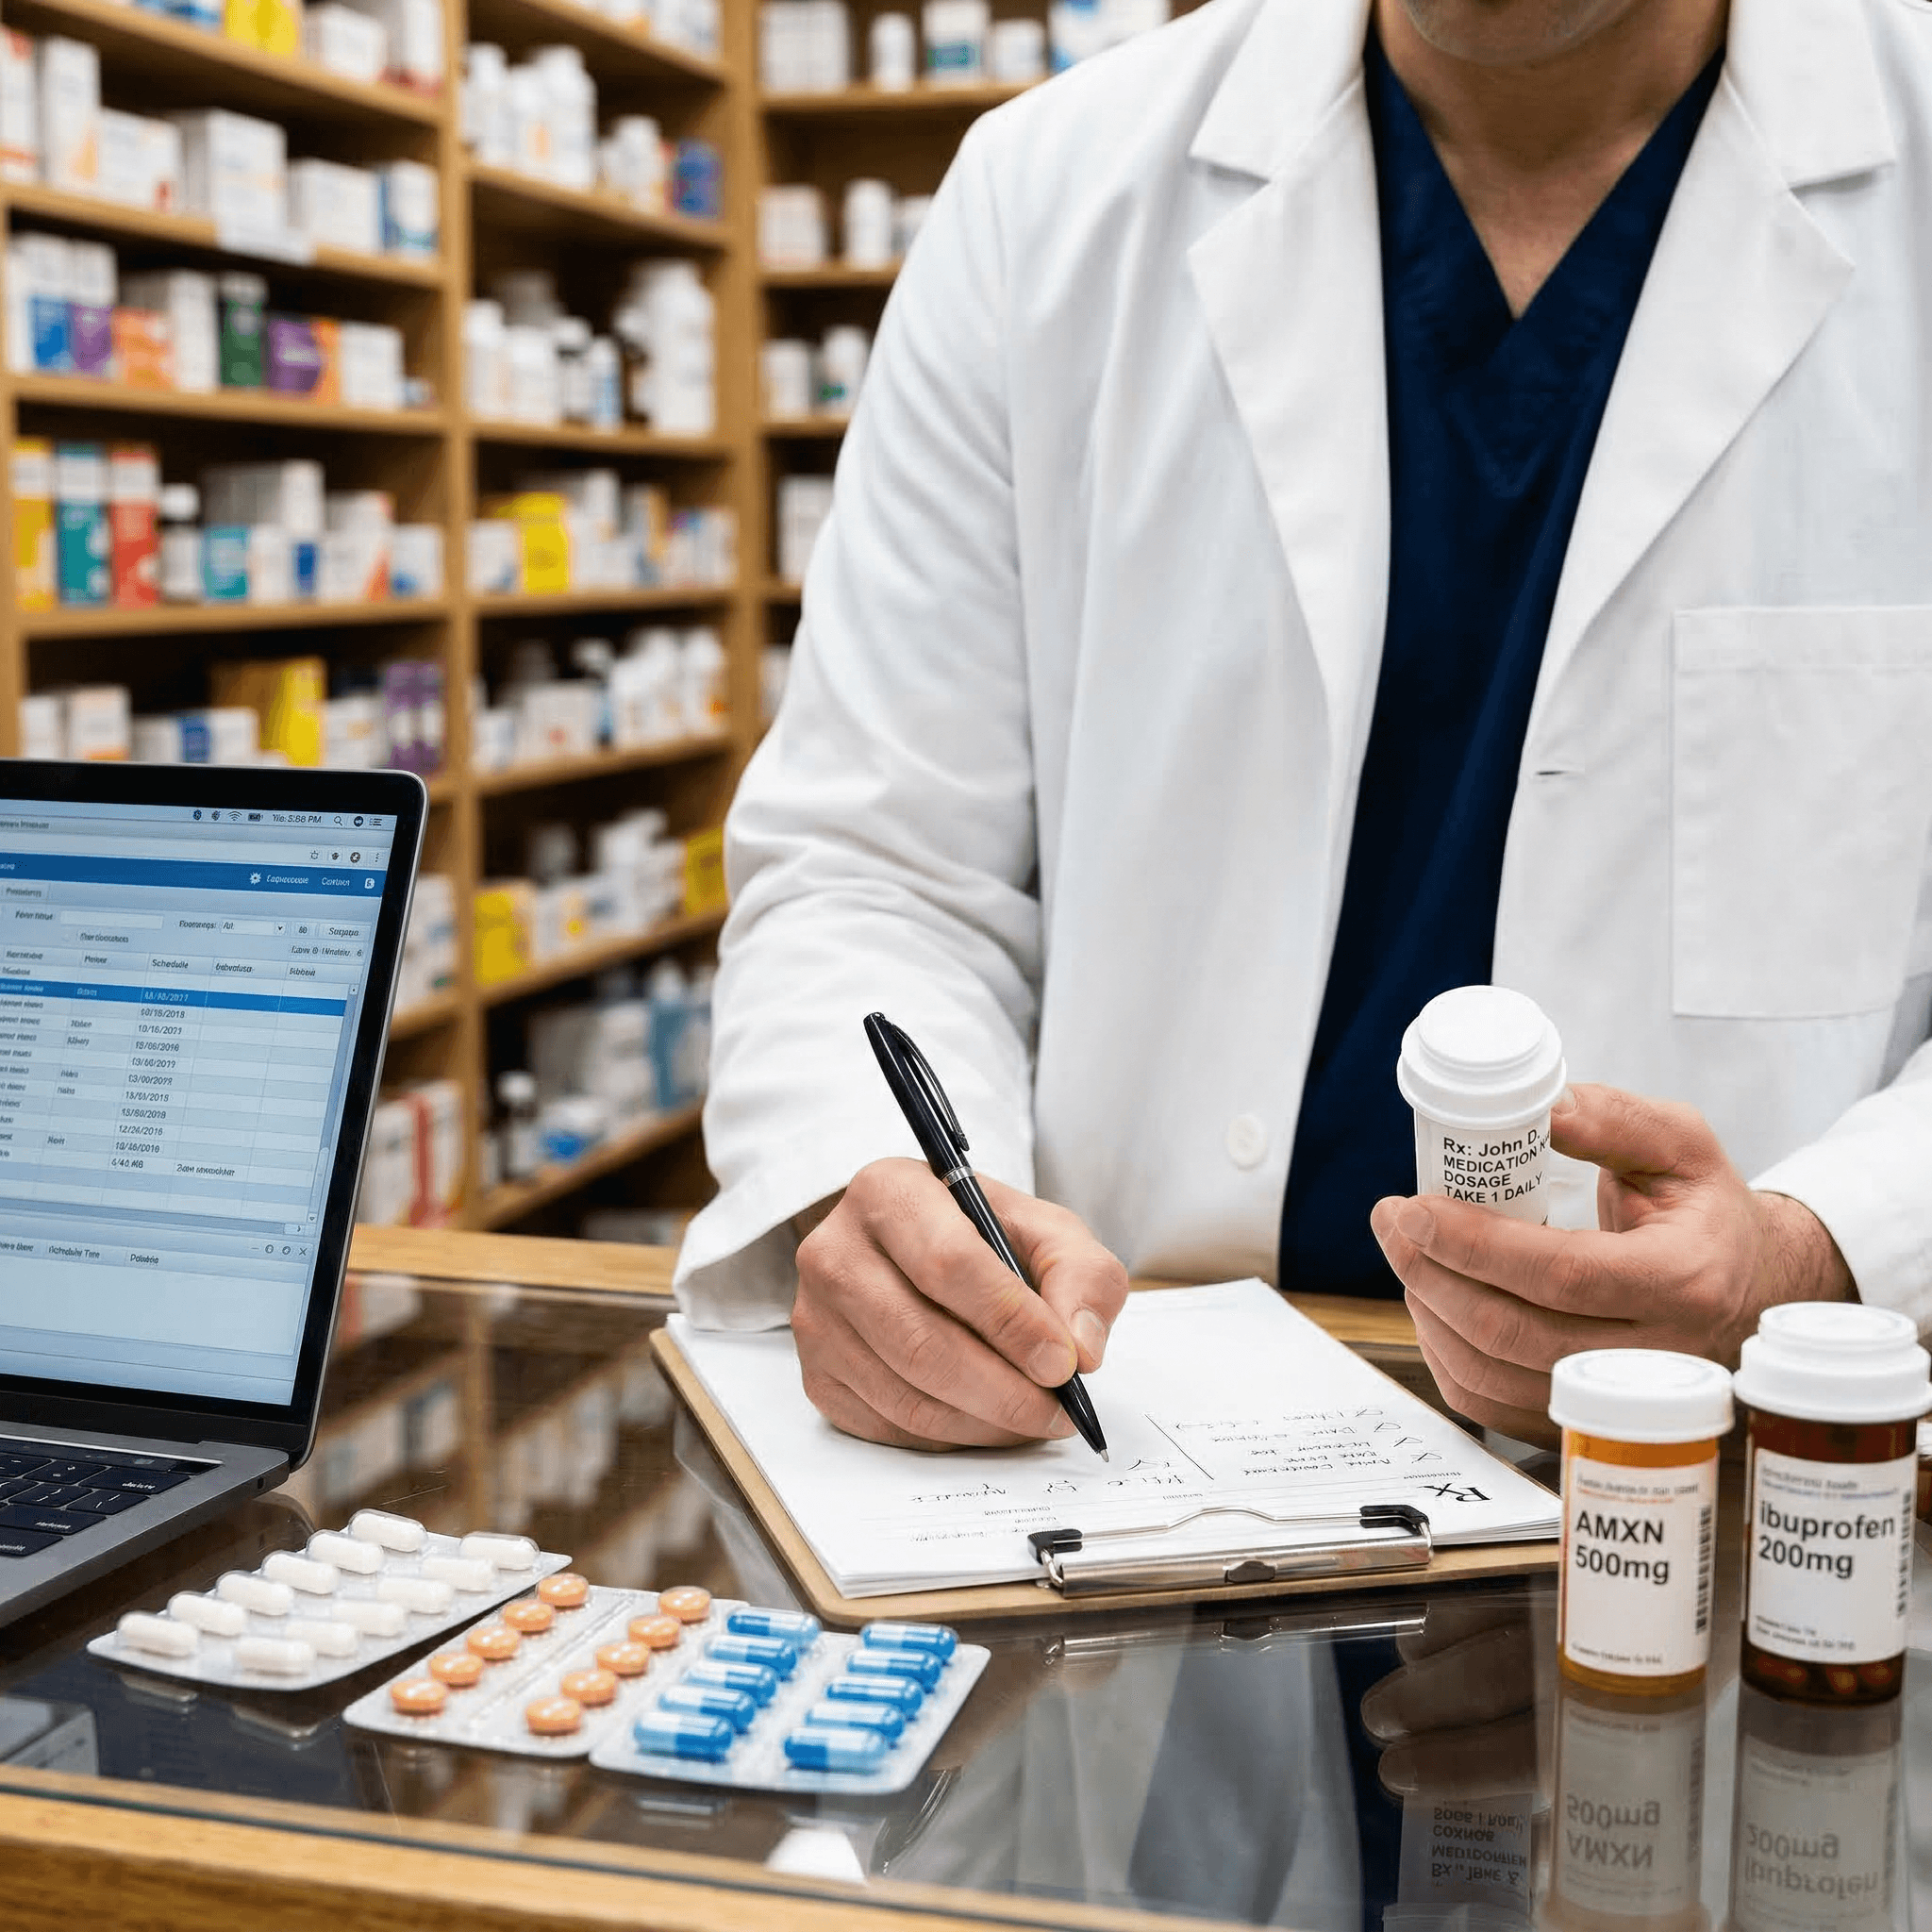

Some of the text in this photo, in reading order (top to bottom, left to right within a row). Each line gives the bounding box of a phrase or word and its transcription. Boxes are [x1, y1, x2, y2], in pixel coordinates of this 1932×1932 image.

[308, 815, 322, 824] PM
[1443, 1137, 1472, 1157] Rx:
[1478, 1140, 1523, 1157] John
[1527, 1129, 1541, 1145] D.
[1443, 1146, 1537, 1173] MEDICATION
[1444, 1170, 1511, 1189] DOSAGE
[1444, 1171, 1542, 1203] TAKE 1 DAILY
[1575, 1510, 1664, 1544] AMXN
[1759, 1500, 1894, 1541] ibuprofen
[1575, 1544, 1669, 1585] 500mg
[1758, 1536, 1854, 1579] 200mg
